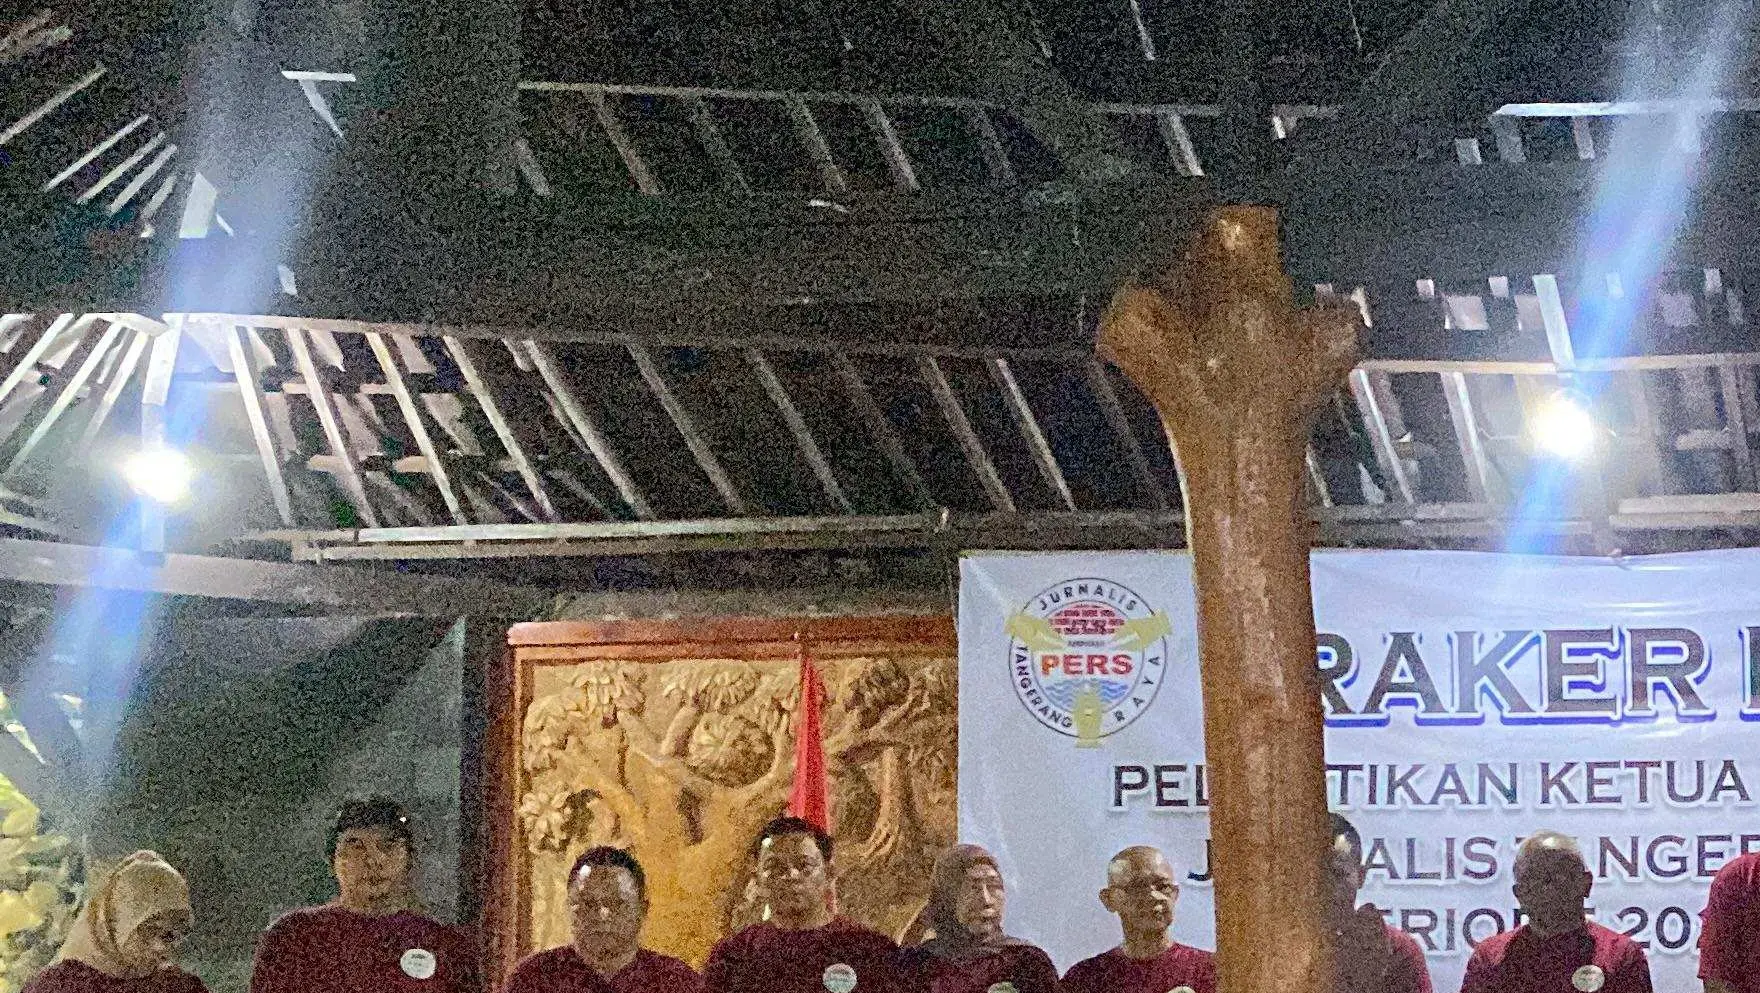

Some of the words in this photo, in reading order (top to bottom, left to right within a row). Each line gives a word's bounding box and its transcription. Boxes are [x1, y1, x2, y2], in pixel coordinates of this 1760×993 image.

[1038, 584, 1138, 611] JURNALIS
[1040, 653, 1134, 676] PERS
[1103, 655, 1161, 722] RAYA
[1540, 759, 1751, 805] KETUA
